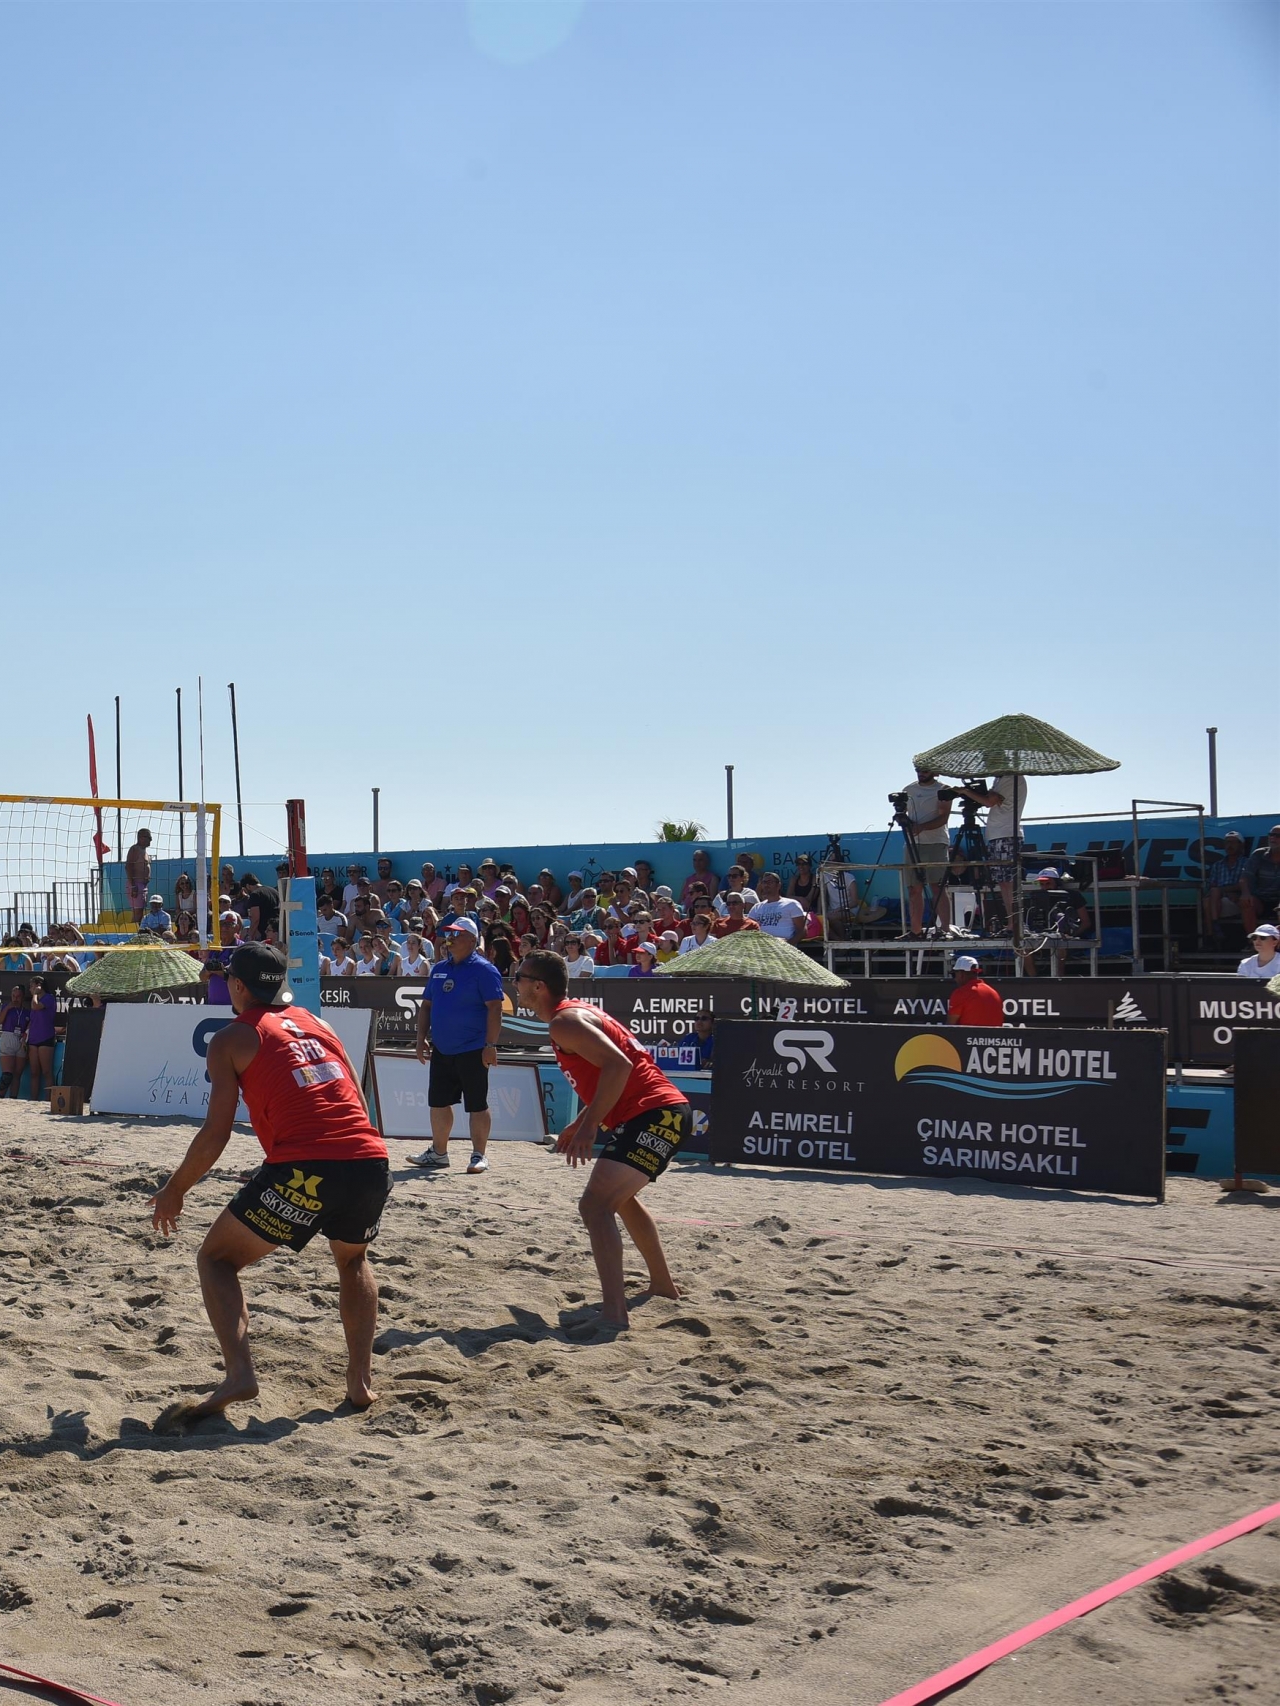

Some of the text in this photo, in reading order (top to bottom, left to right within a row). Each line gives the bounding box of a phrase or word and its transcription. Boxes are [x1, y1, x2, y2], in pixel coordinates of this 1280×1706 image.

[260, 972, 286, 981] SKYB
[780, 1005, 791, 1019] 2
[803, 998, 868, 1015] HOTEL
[893, 998, 1060, 1016] AYVA OTEL
[629, 1017, 695, 1034] SUİT OT
[288, 1038, 327, 1063] SRB
[966, 1037, 1023, 1047] SARIMSAKLI
[680, 1049, 693, 1064] 15
[965, 1047, 1117, 1080] ACEM HOTEL
[745, 1076, 867, 1093] SEA RESORT
[150, 1089, 189, 1105] SEA
[747, 1111, 853, 1134] A.EMRELİ
[916, 1117, 1087, 1148] ÇINAR HOTEL
[639, 1132, 671, 1156] SKYBA
[742, 1133, 857, 1162] SUİT OTEL
[922, 1145, 1078, 1176] SARIMSAKLI
[262, 1191, 316, 1225] SKYBALL
[274, 1182, 324, 1211] XTEND
[244, 1208, 295, 1241] DESIGNS
[256, 1207, 292, 1233] RHINO
